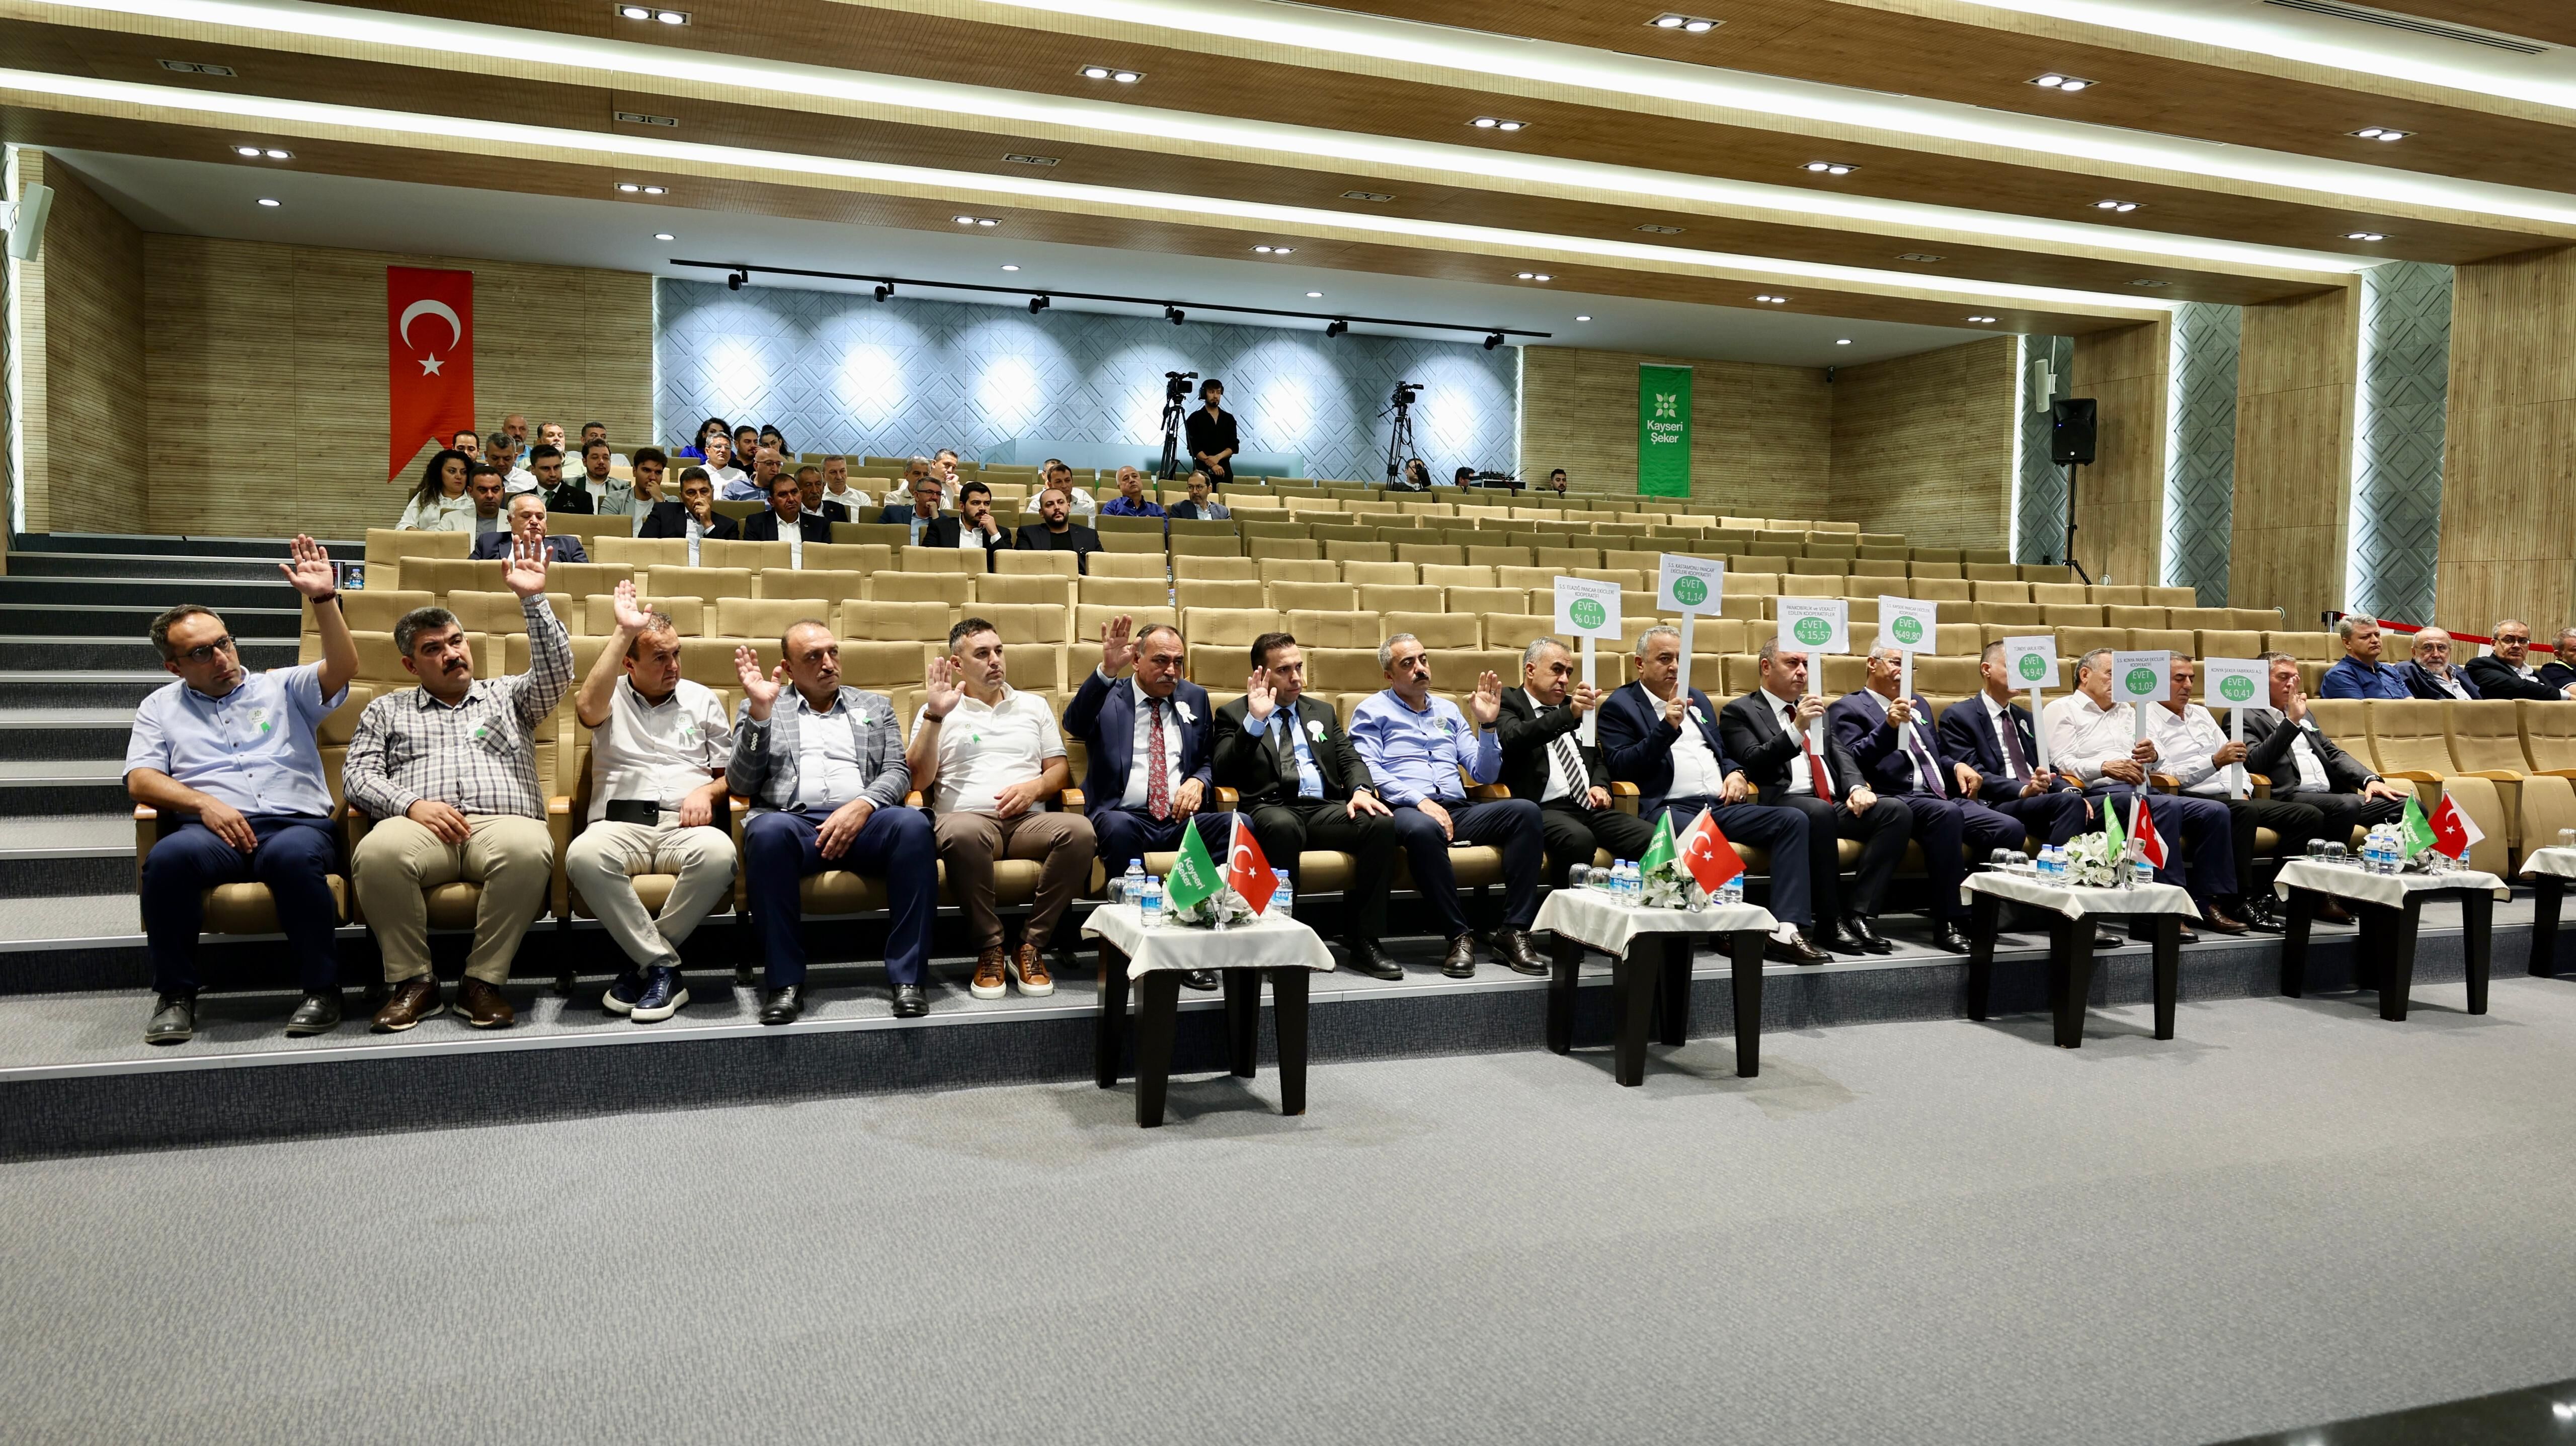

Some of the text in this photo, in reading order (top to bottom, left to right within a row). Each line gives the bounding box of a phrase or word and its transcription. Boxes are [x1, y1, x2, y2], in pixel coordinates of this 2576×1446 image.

[1647, 420, 1683, 432] Kayseri
[1651, 432, 1679, 444] Şeker
[1681, 578, 1701, 589] EVET
[1678, 590, 1703, 602] % 1,14
[1578, 601, 1598, 611] EVET
[1575, 613, 1601, 625] % 0,11
[1802, 620, 1824, 628] EVET
[1899, 618, 1916, 628] EVET
[1797, 630, 1831, 640] % 15,57
[2024, 656, 2040, 665] EVET
[2023, 668, 2044, 678] % 9,41
[2133, 671, 2150, 679] EVET
[2130, 682, 2153, 691] % 1,03
[2227, 678, 2247, 686] EVET
[2225, 689, 2251, 698] % 0,41
[1174, 862, 1192, 887] Şeker
[1183, 856, 1205, 890] Kayseri
